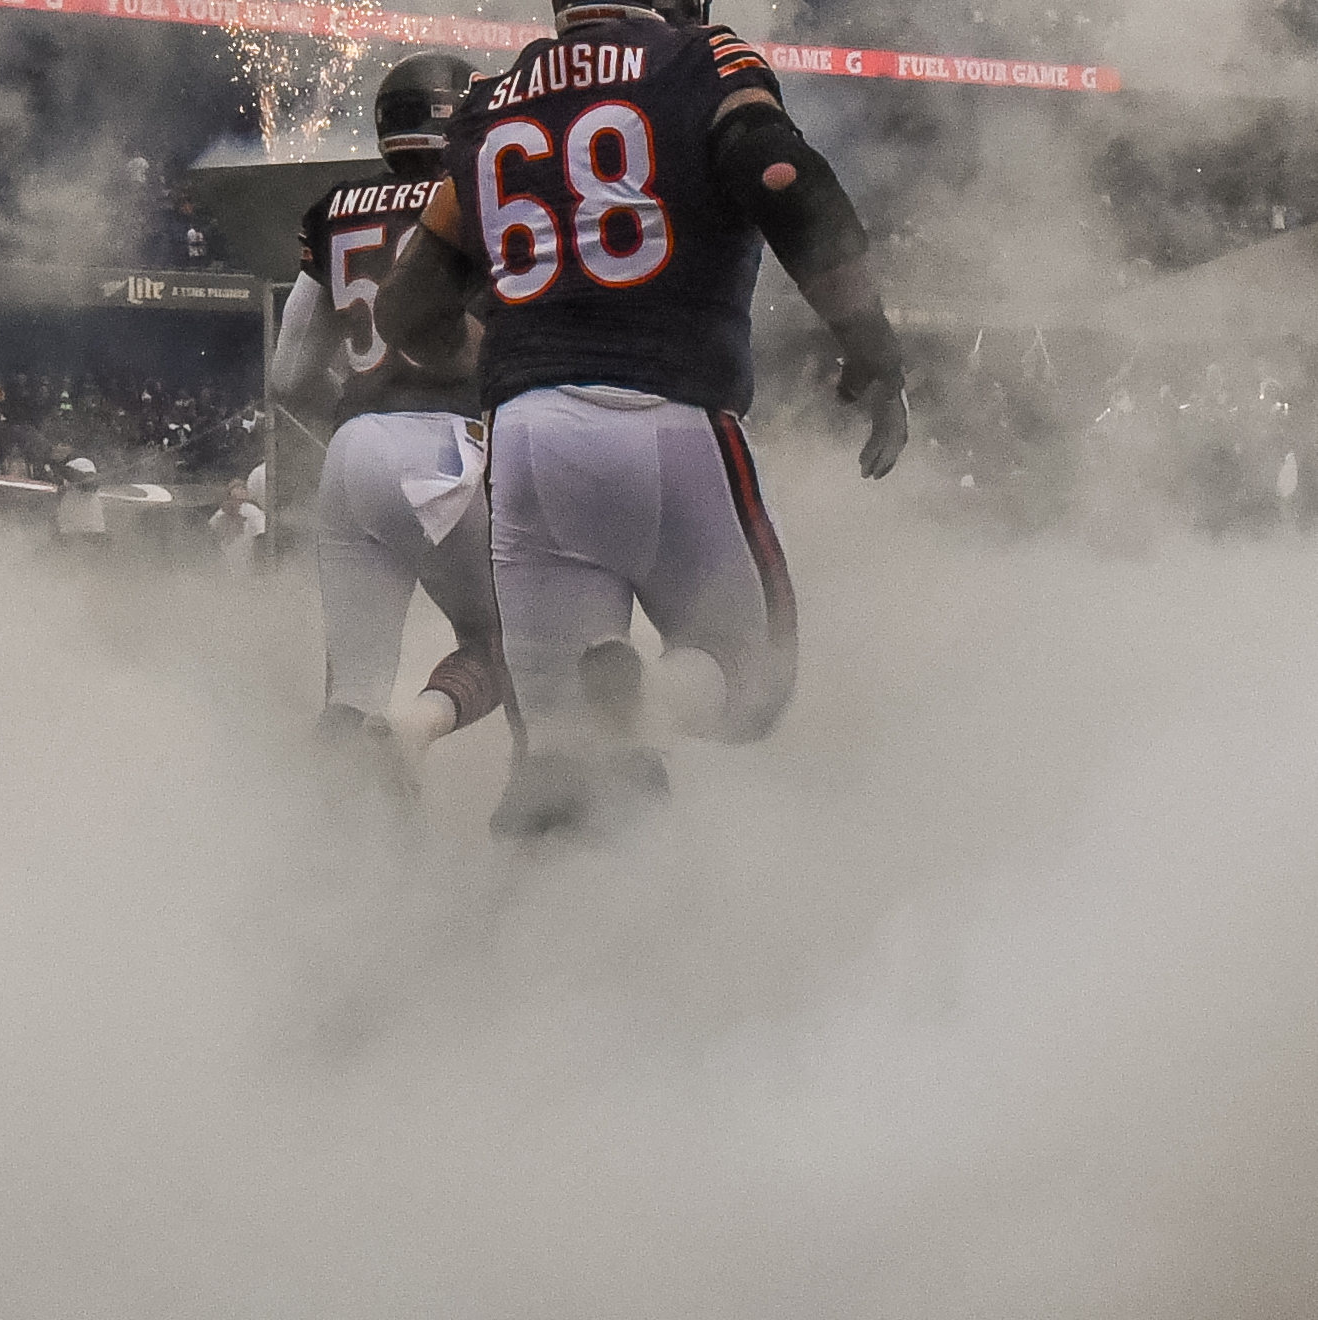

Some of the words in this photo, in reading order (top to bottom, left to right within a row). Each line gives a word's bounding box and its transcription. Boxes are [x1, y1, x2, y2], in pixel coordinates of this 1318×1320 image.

[487, 43, 645, 111] SLAUSON
[772, 46, 832, 71] GAME
[898, 54, 950, 79] FUEL
[952, 58, 1007, 82] YOUR
[1012, 62, 1069, 87] GAME
[477, 99, 674, 305] 68
[330, 223, 423, 373] 5
